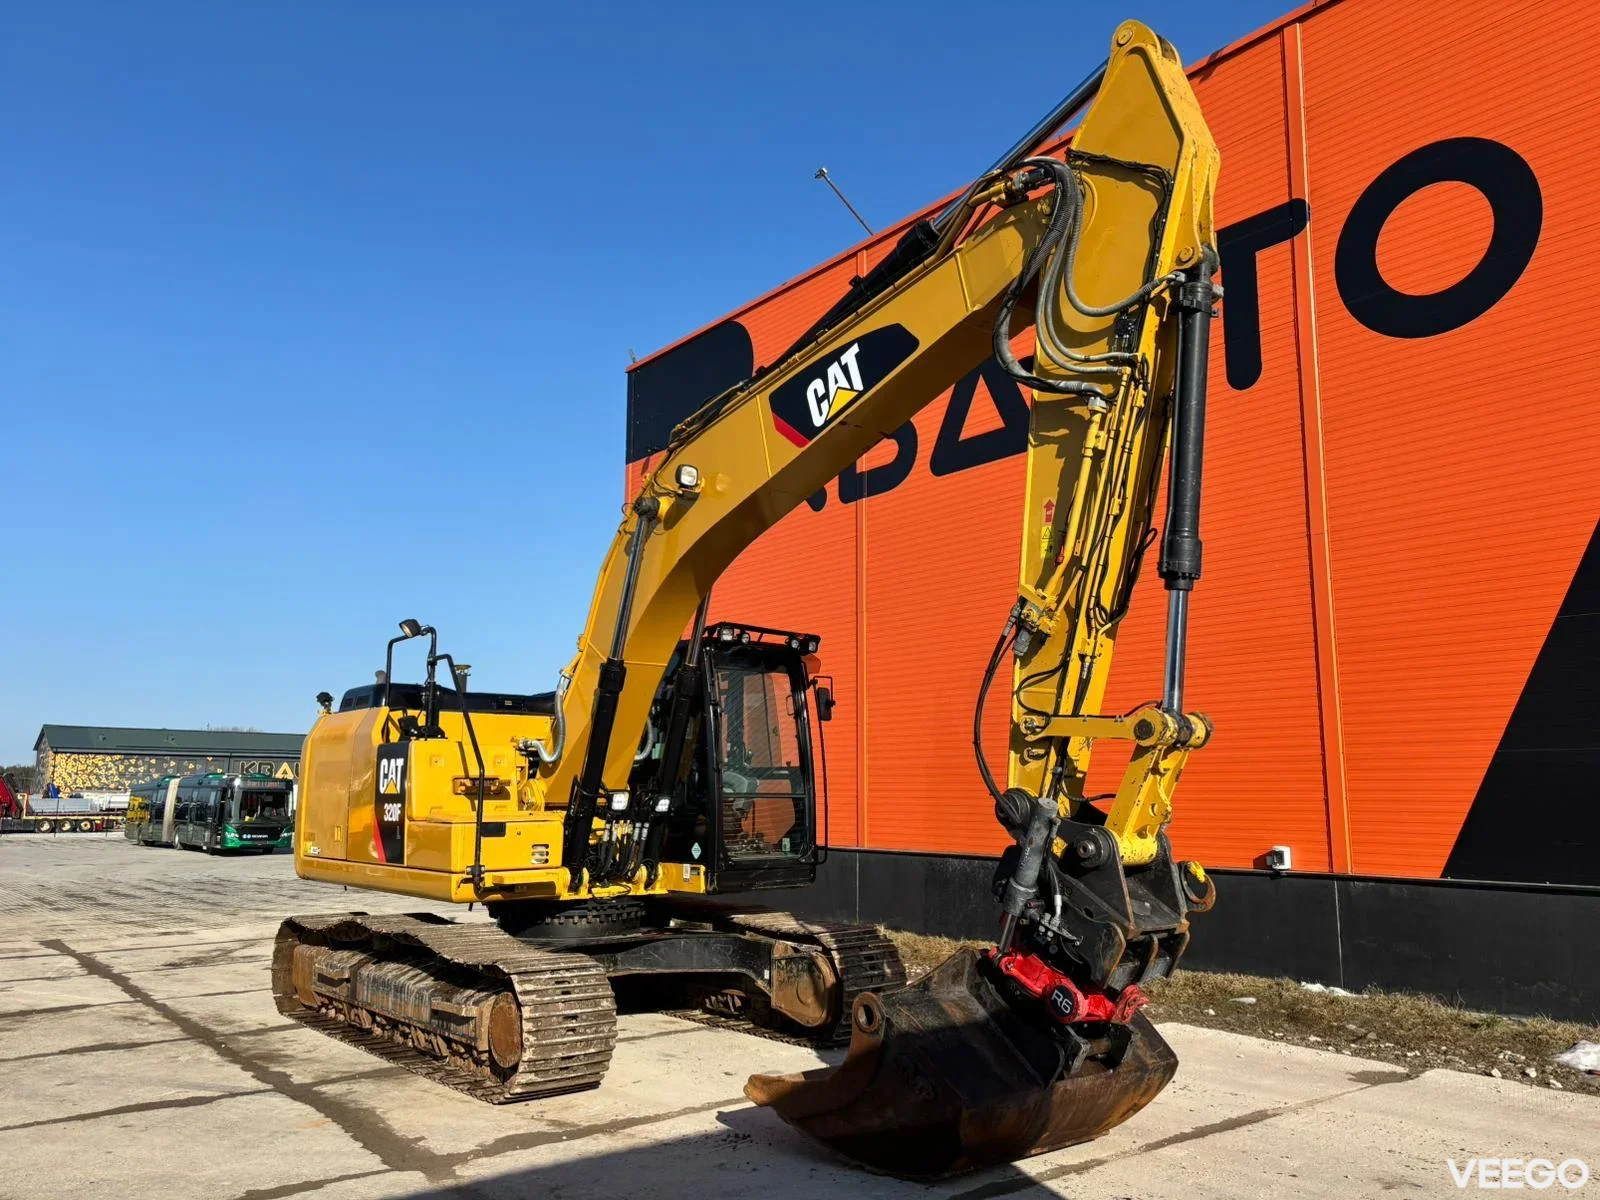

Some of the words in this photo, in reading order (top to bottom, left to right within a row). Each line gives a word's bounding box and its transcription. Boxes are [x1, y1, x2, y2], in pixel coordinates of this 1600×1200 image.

[806, 342, 864, 428] CAT
[379, 758, 404, 794] CAT
[383, 803, 402, 822] 320F
[1051, 989, 1073, 1014] R6
